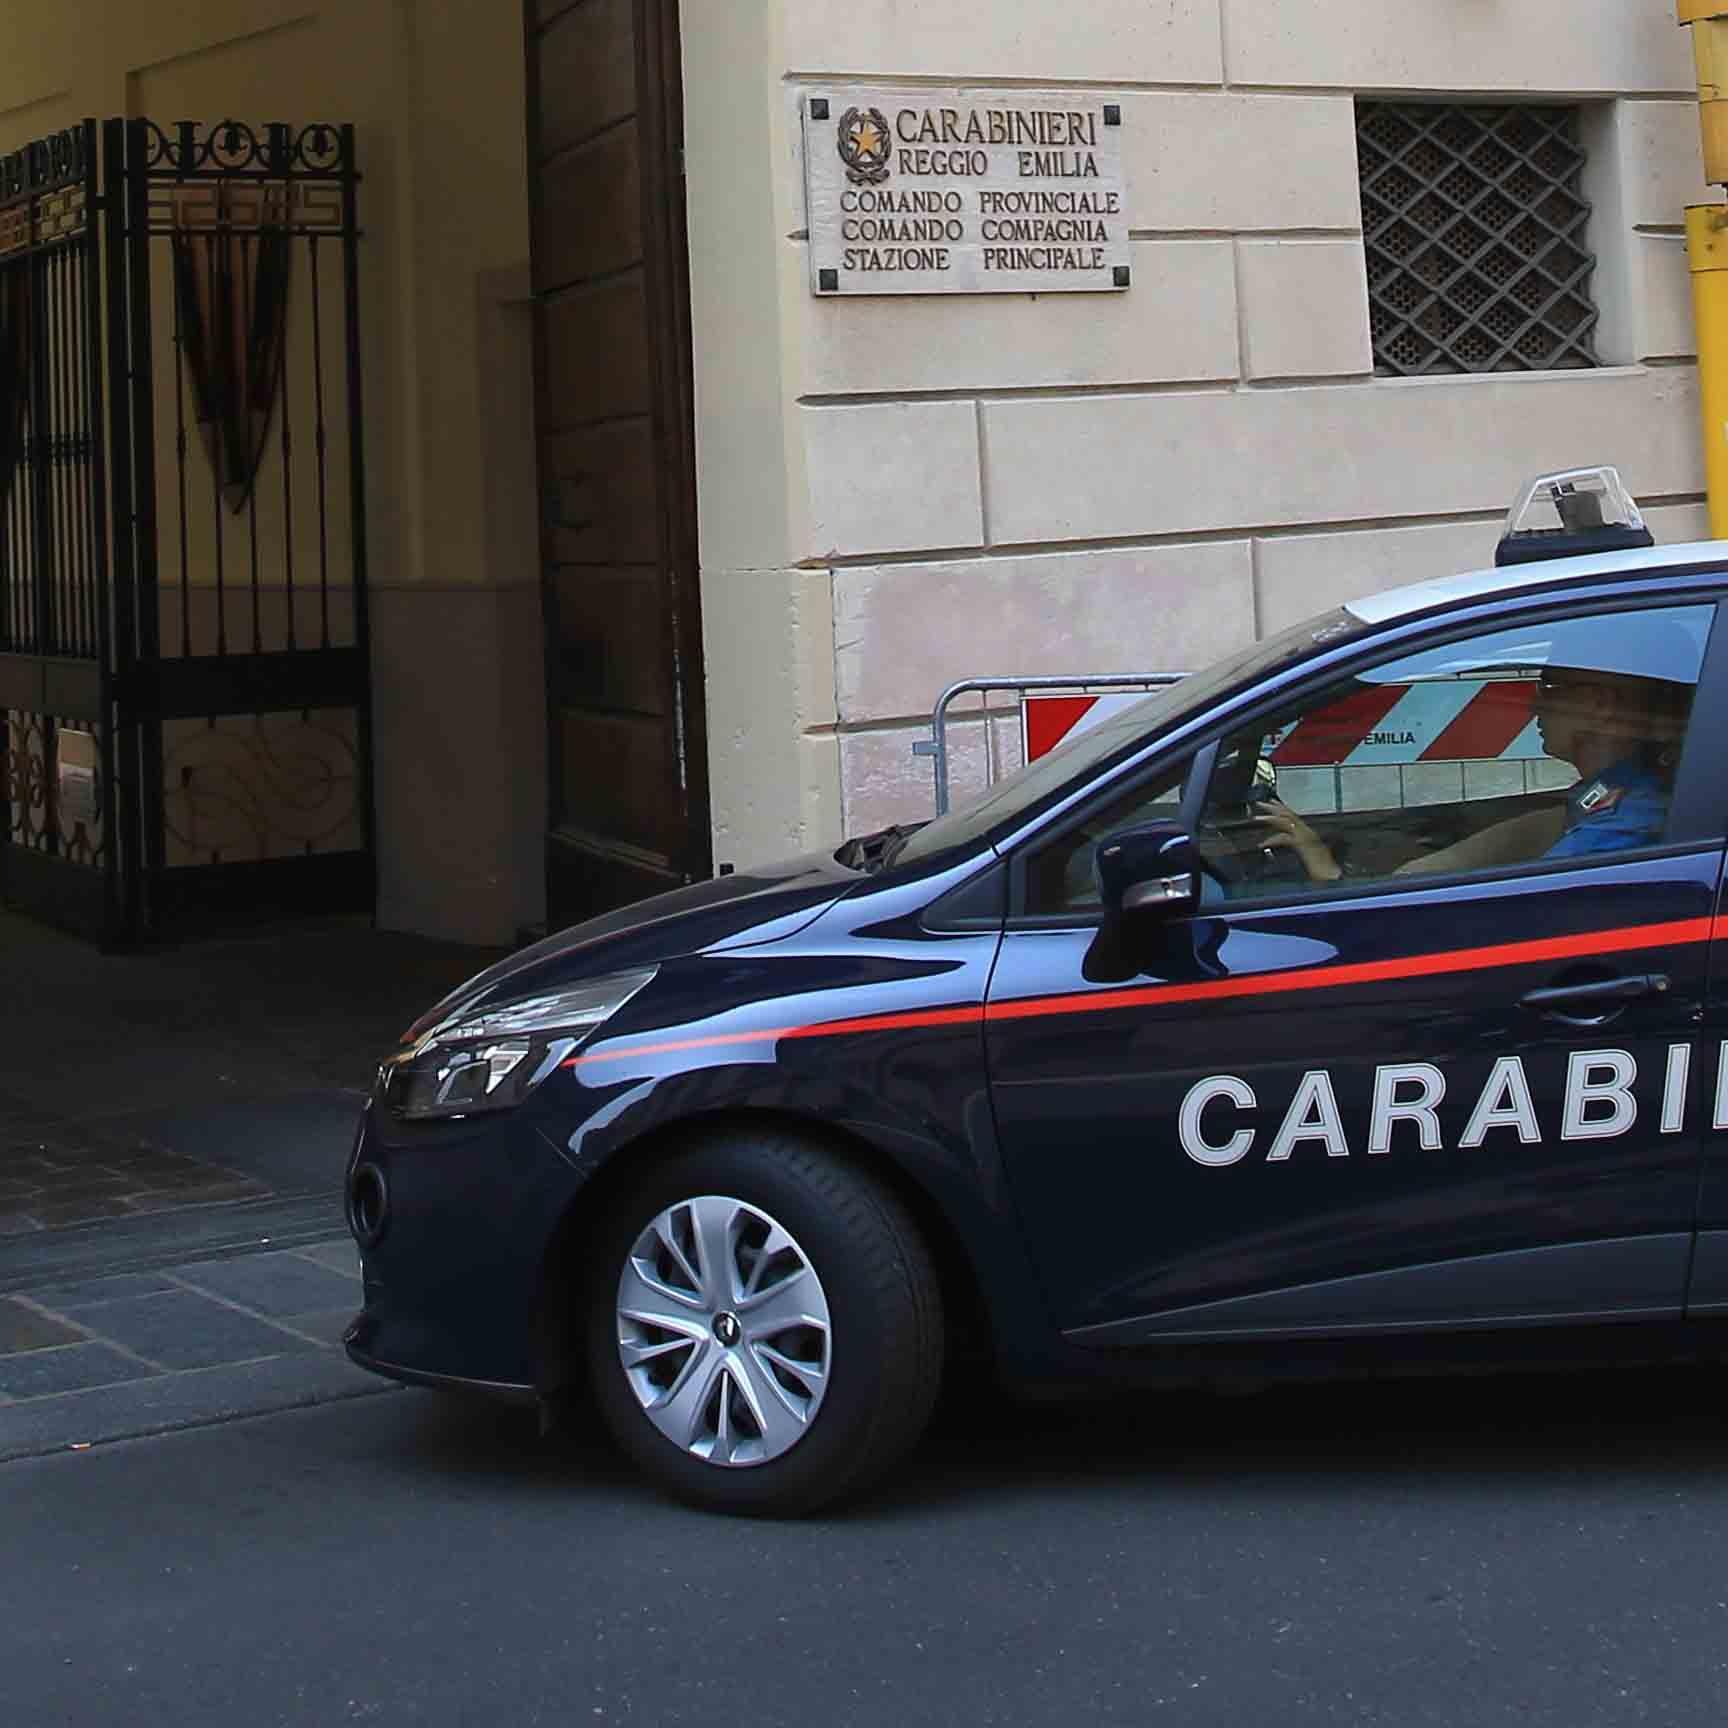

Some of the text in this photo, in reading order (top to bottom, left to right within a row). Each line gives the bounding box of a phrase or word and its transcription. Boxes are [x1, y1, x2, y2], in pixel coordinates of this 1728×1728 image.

[895, 108, 1097, 147] CARABINIERI
[897, 148, 1100, 178] REGGIO EMILIA
[839, 190, 1121, 215] COMANDO PROVINCIALE
[841, 219, 1110, 242] COMANDO COMPAGNIA
[842, 247, 1107, 271] STAZIONE PRINCIPALE
[1364, 731, 1416, 745] EMILIA
